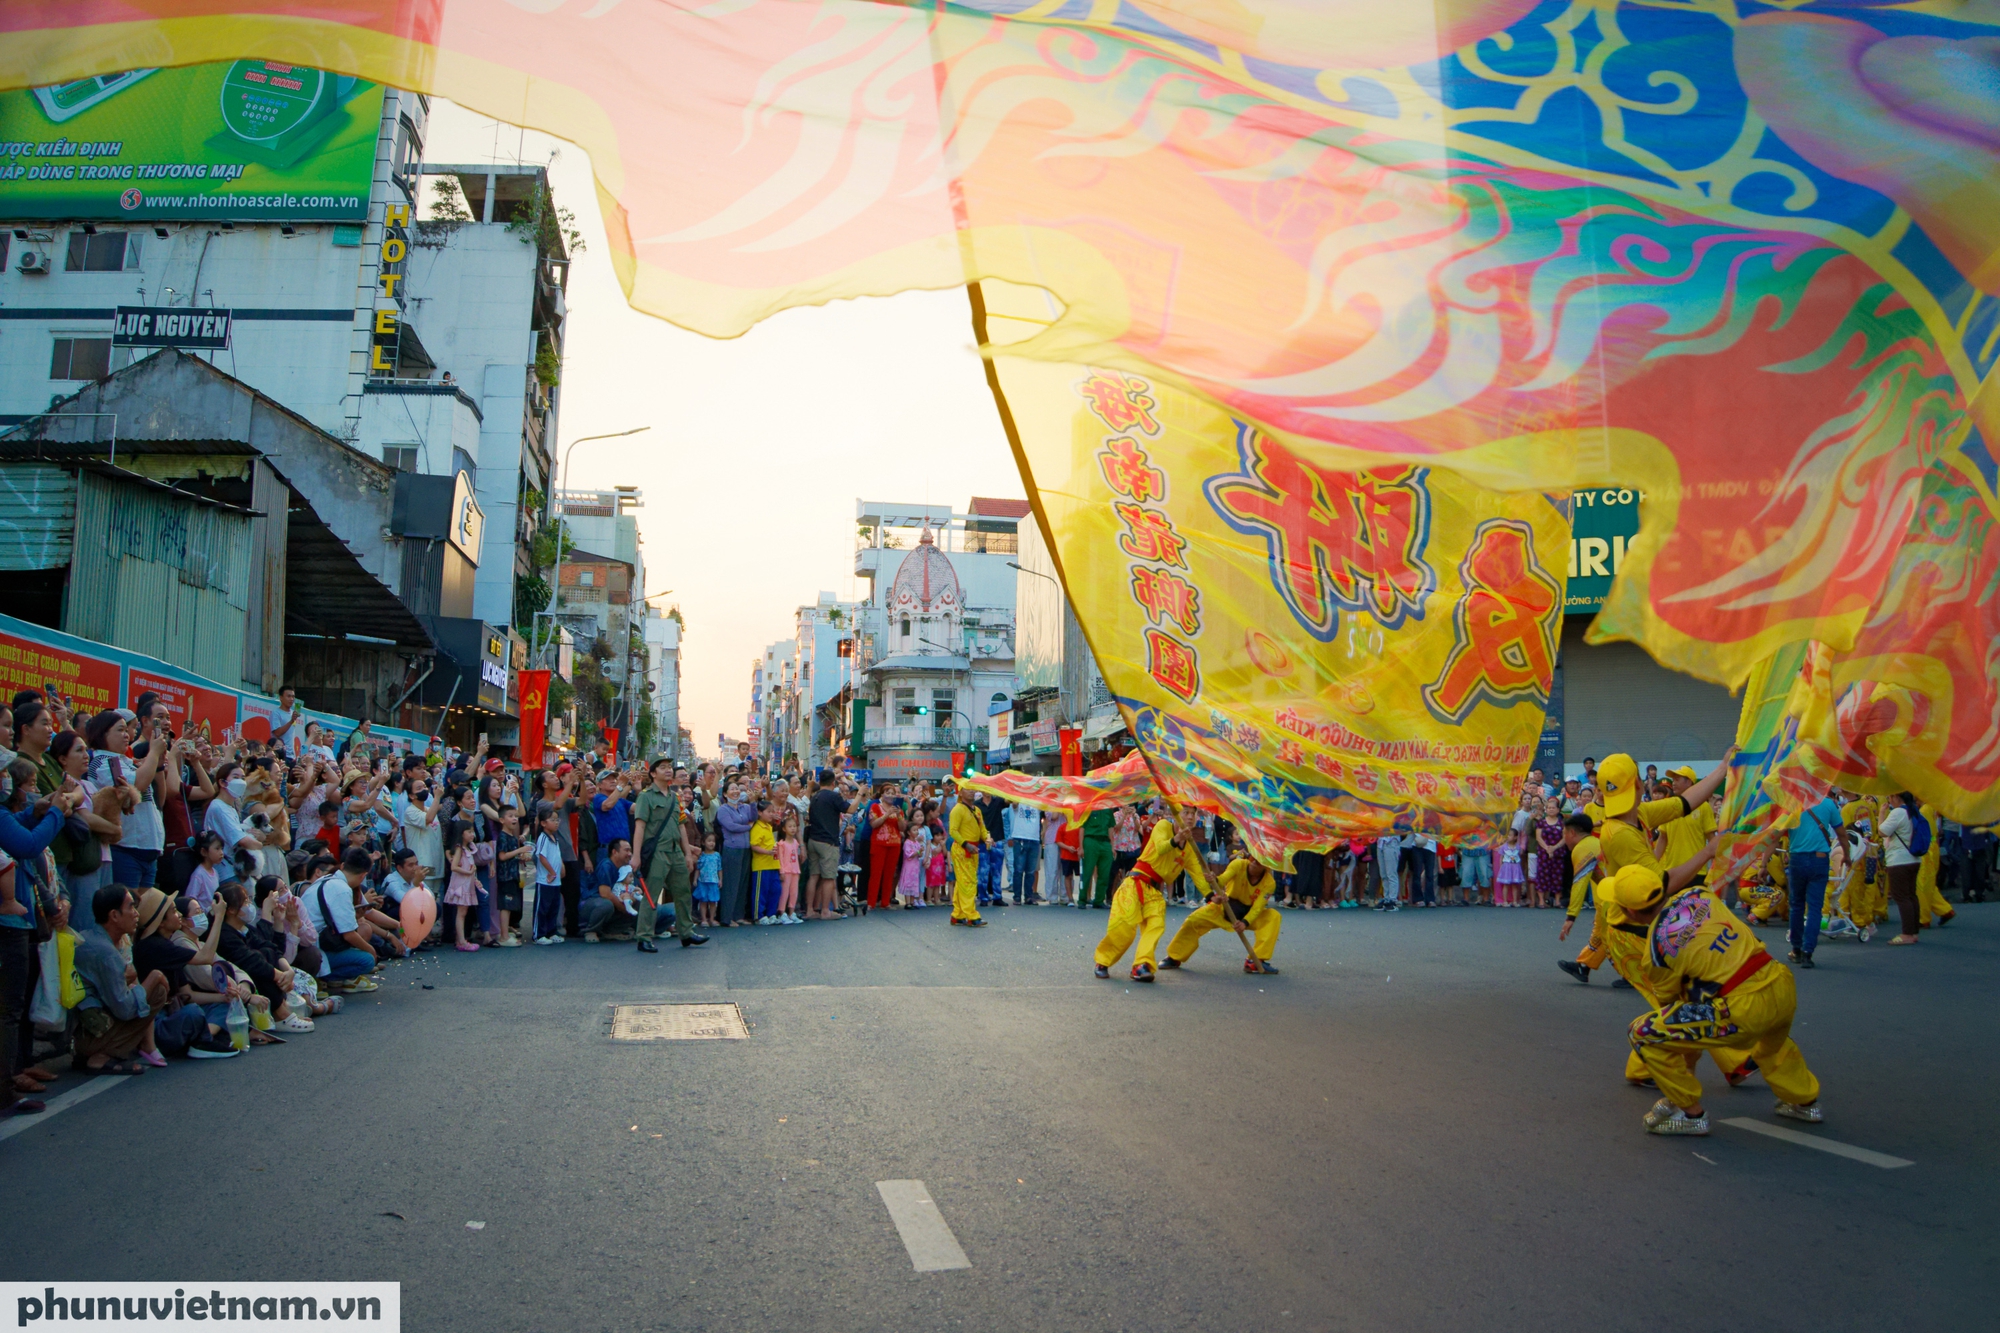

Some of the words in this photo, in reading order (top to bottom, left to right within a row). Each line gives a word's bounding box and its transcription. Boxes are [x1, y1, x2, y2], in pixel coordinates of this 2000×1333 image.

[36, 137, 78, 157] KIỂM
[79, 142, 122, 160] ĐỊNH
[0, 163, 25, 180] ÁP
[27, 162, 75, 180] DÙNG
[78, 164, 134, 180] TRONG
[137, 163, 208, 178] THƯƠNG
[209, 164, 244, 182] MẠI
[145, 193, 359, 209] www.nhonhoascale.com.vn
[371, 204, 411, 370] HOTEL
[114, 313, 151, 342] LỤC
[154, 310, 228, 338] NGUYÊN
[22, 648, 40, 669] LIỆT
[41, 654, 59, 672] CHÀO
[97, 687, 109, 703] XVI
[1543, 748, 1556, 757] 162
